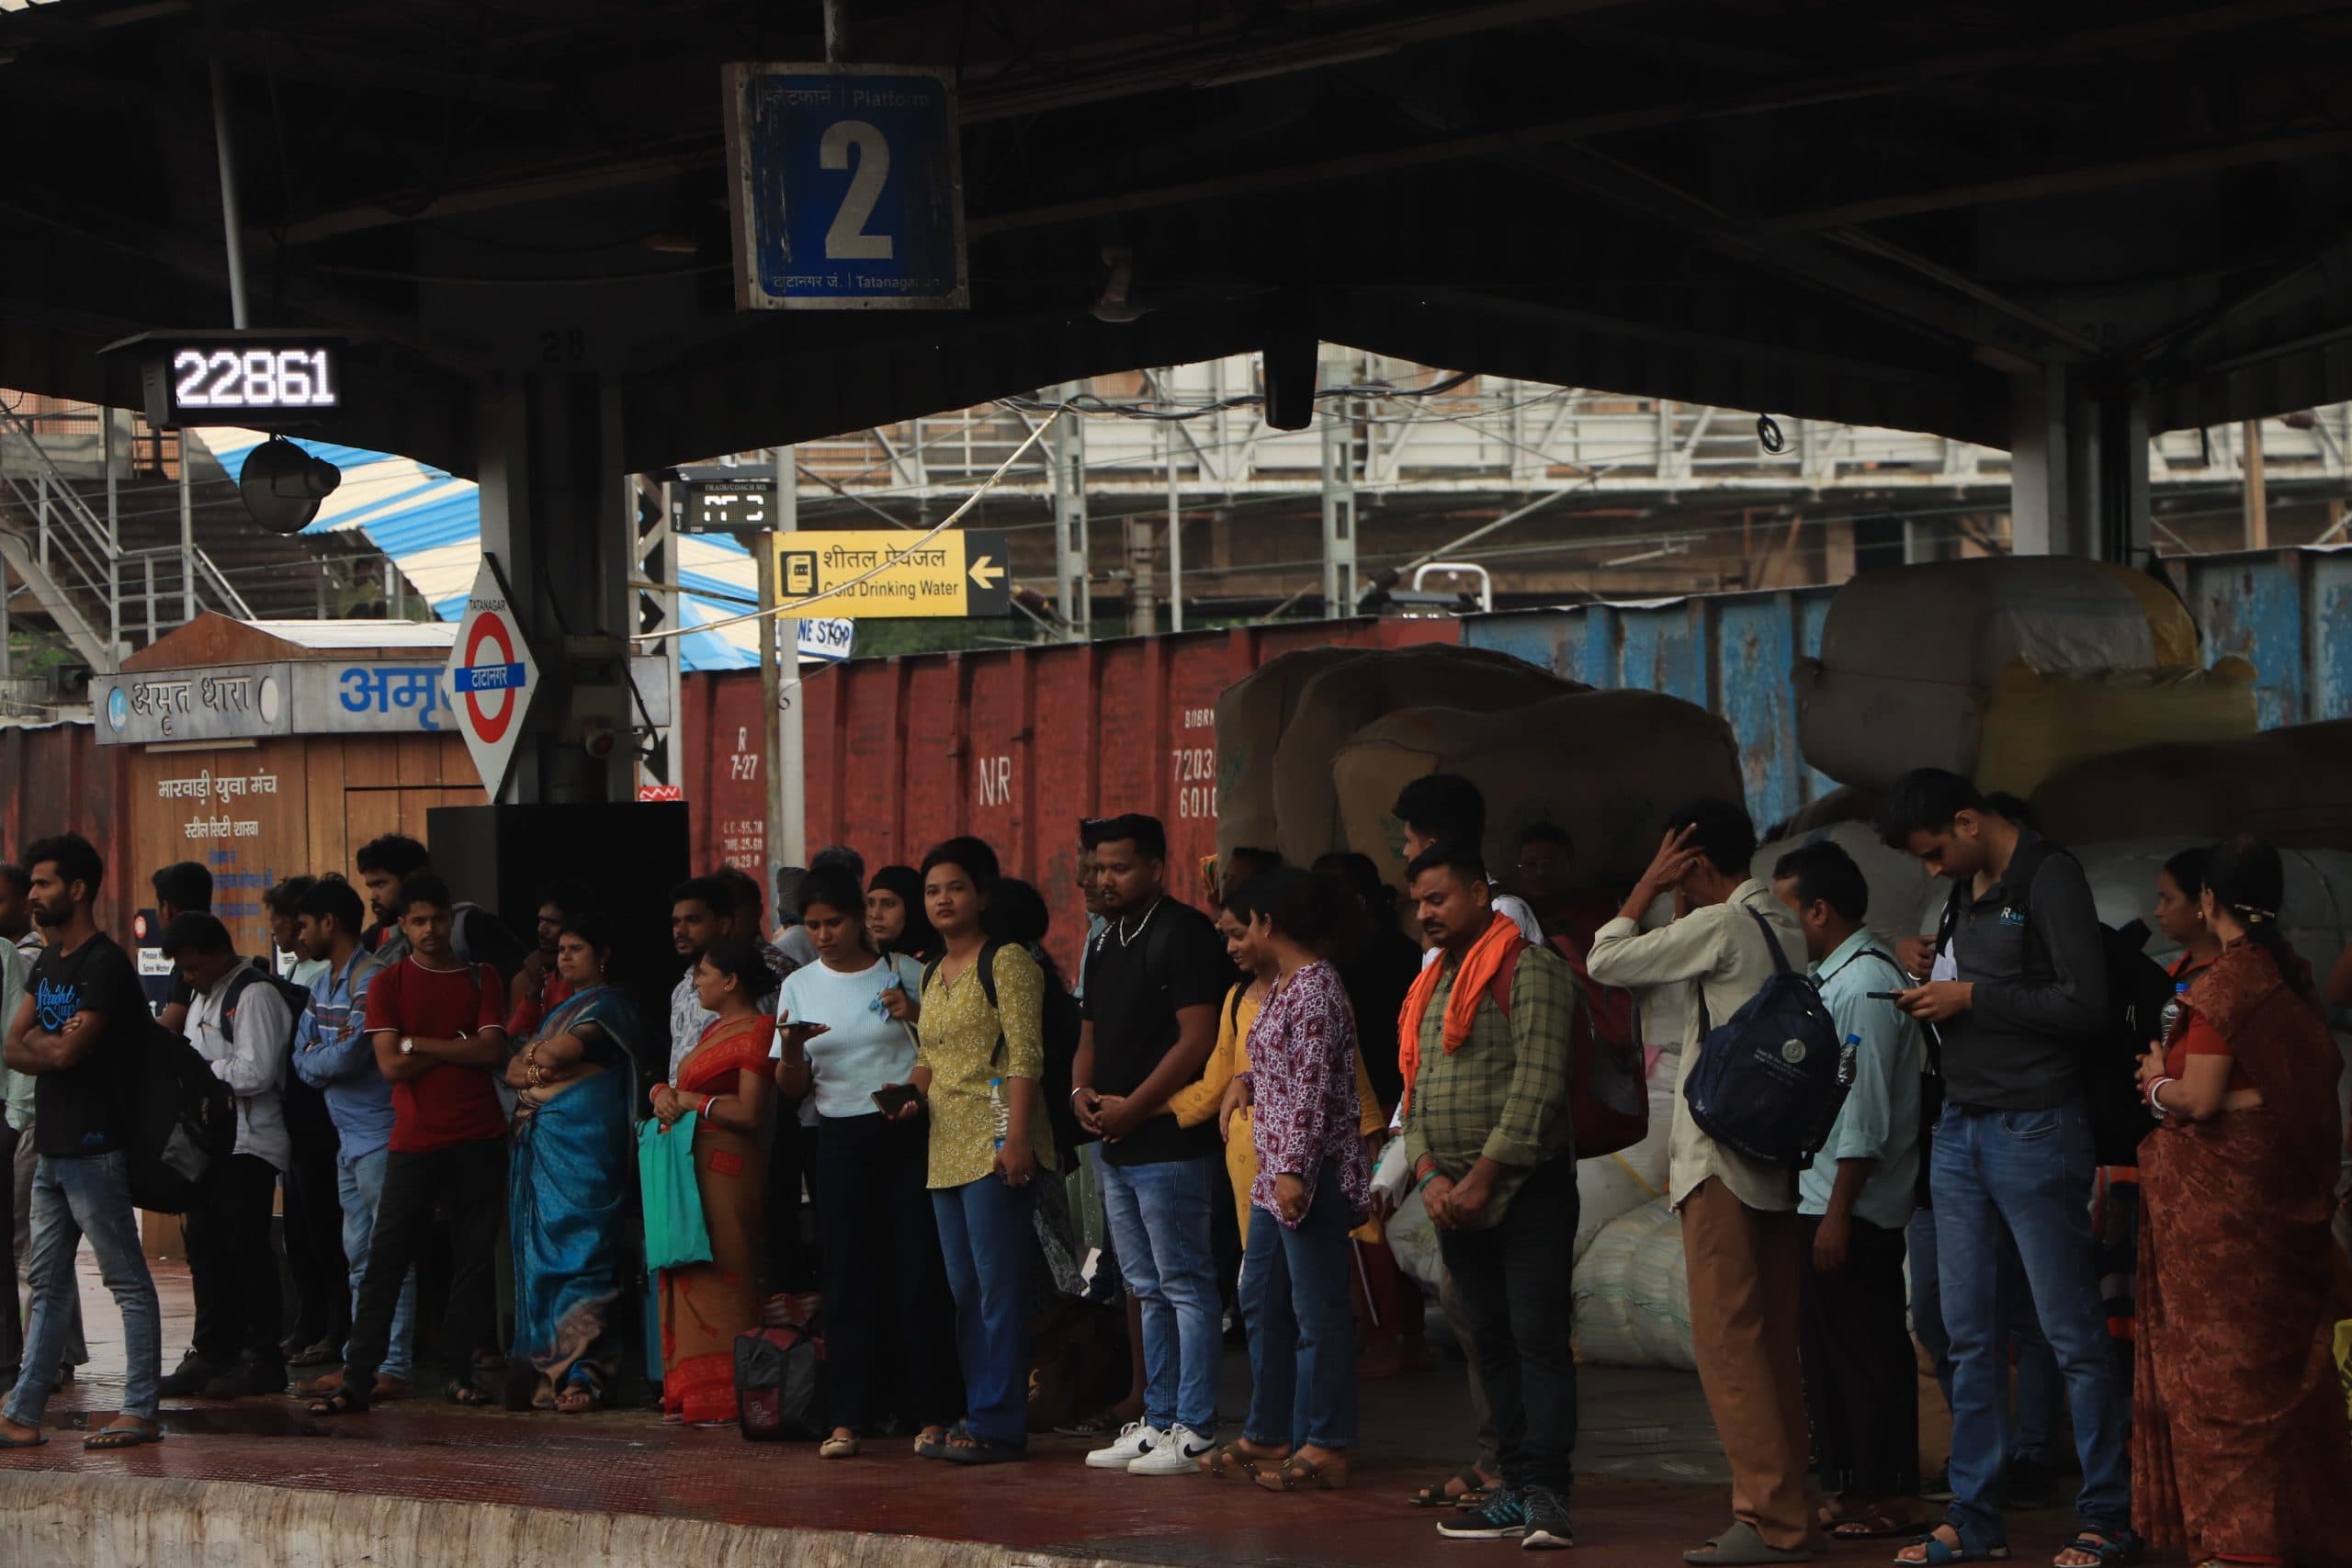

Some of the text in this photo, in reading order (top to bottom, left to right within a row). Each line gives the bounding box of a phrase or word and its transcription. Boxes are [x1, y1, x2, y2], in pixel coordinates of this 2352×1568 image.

[853, 90, 929, 107] Platform
[820, 120, 893, 259] 2
[175, 350, 335, 405] 22861
[823, 544, 877, 569] शीतल
[860, 581, 916, 600] Drinking
[920, 581, 959, 596] Water
[469, 599, 506, 612] TATANAGAR
[816, 621, 850, 648] STOP
[470, 666, 508, 689] टाटानगर
[130, 676, 254, 736] अमृत धारा
[339, 666, 452, 731] अमृ
[738, 727, 748, 751] R
[730, 754, 758, 780] 7-27
[1172, 748, 1217, 784] 7203
[158, 767, 278, 806] मारवाड़ी युवा मंच
[979, 756, 1012, 807] NR
[185, 816, 209, 839] स्टील
[209, 815, 231, 838] सिटी
